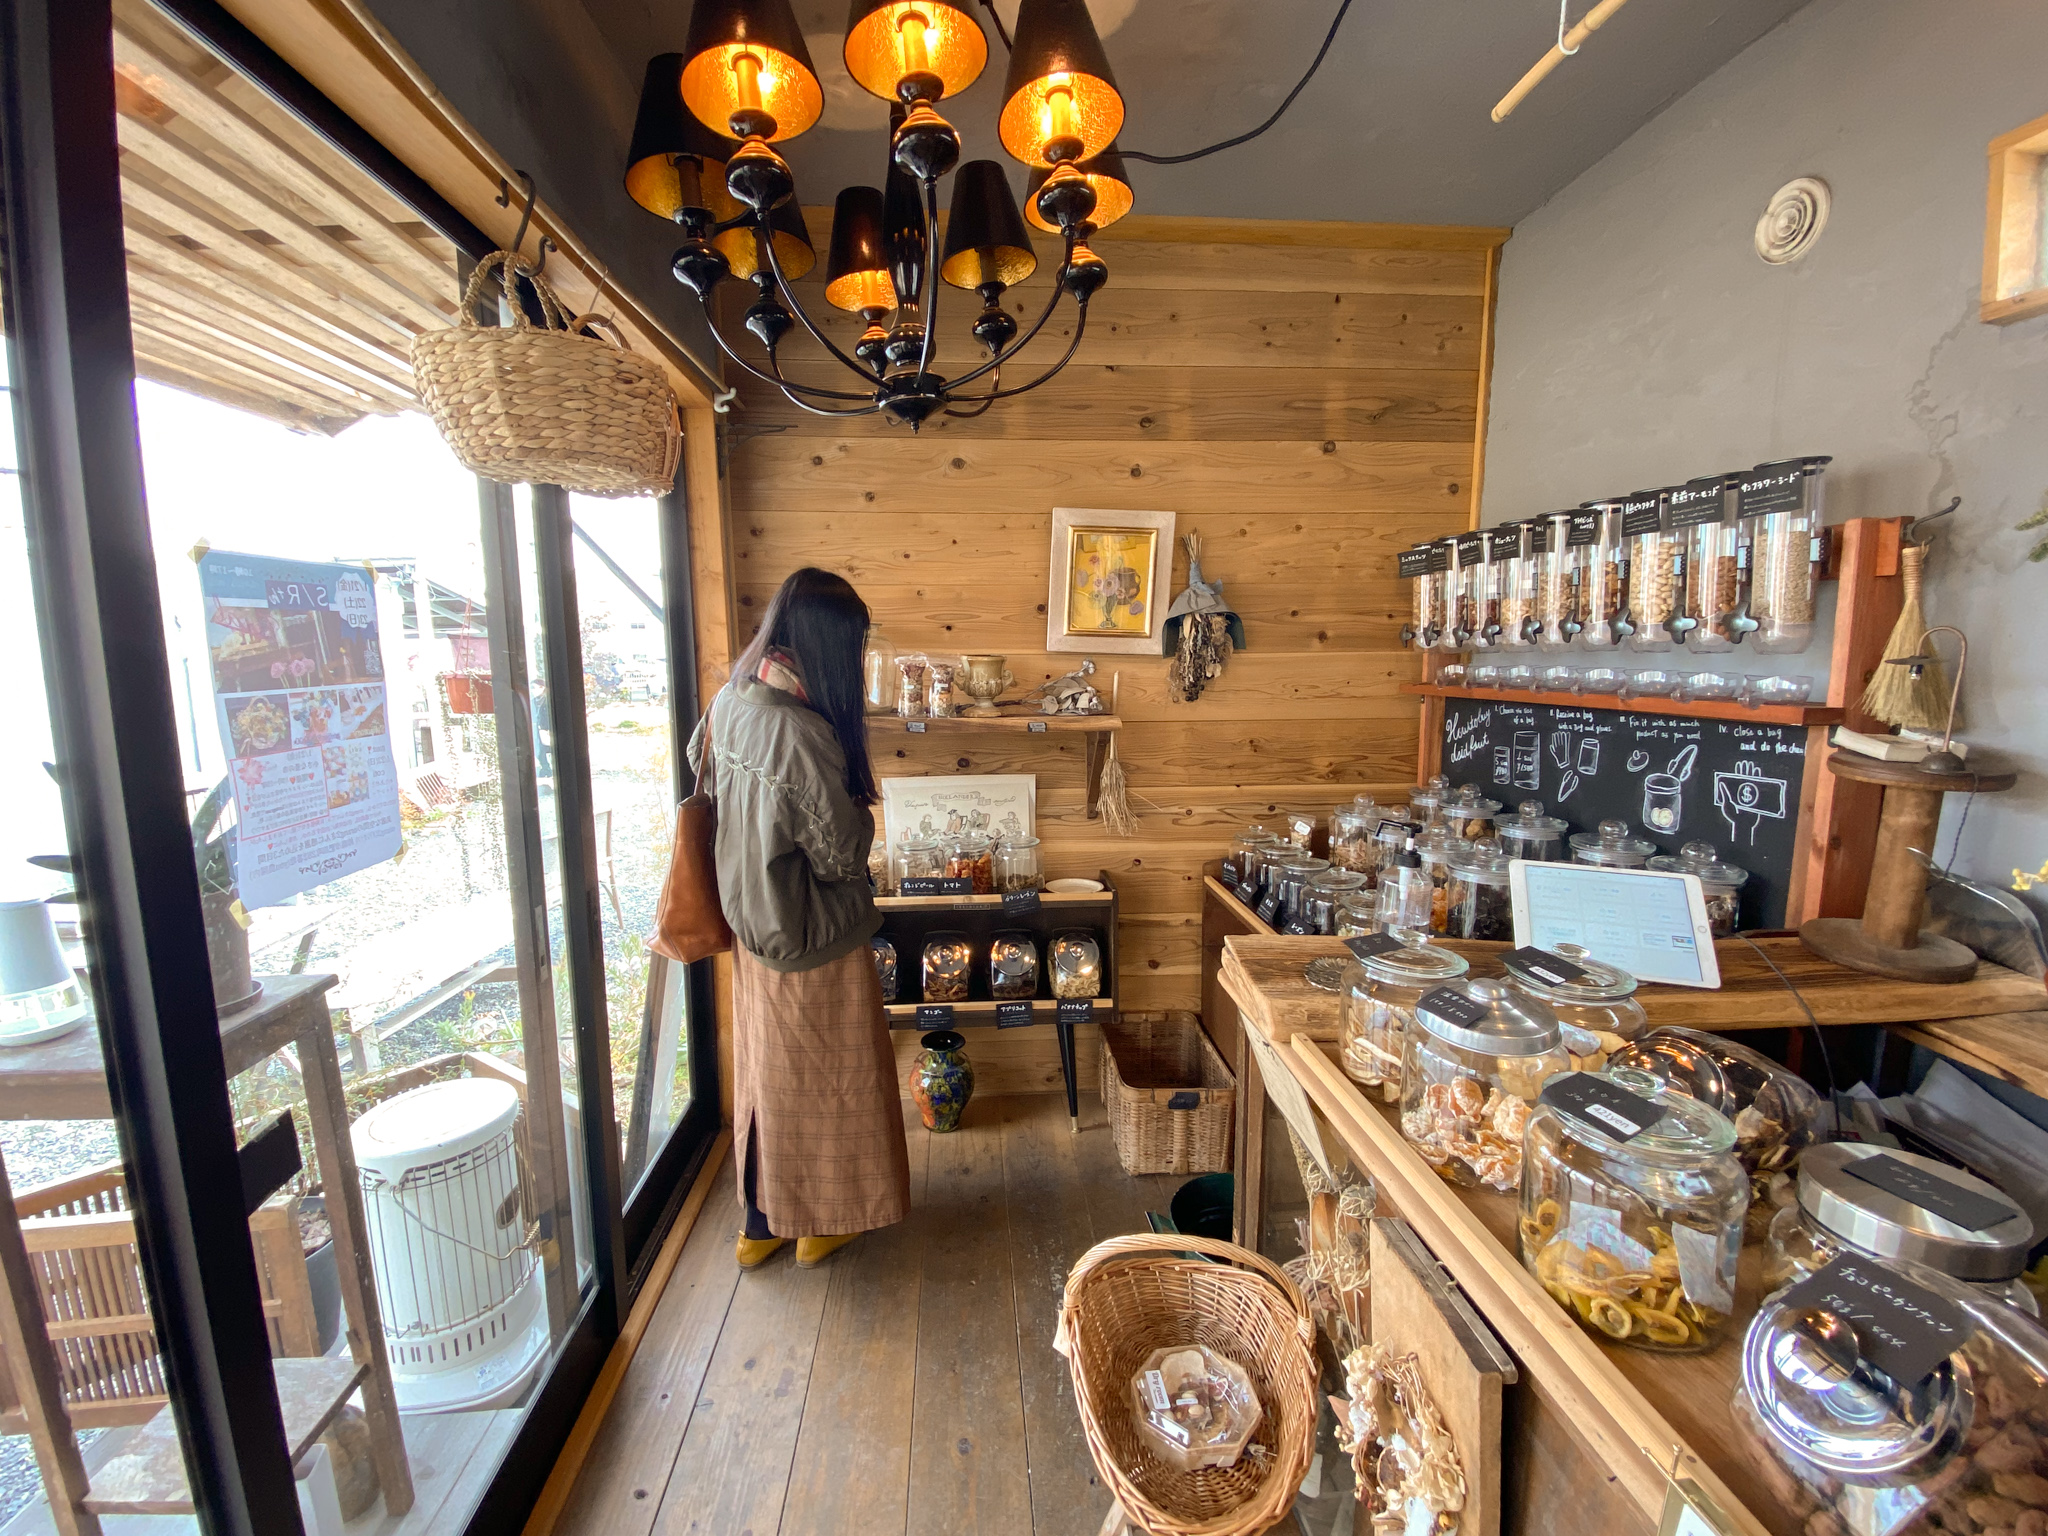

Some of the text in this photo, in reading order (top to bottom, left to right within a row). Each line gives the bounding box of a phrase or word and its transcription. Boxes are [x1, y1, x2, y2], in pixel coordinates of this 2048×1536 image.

[1756, 728, 1764, 736] a
[1766, 727, 1782, 740] bag
[1739, 740, 1757, 751] and
[943, 881, 962, 889] トマト
[1591, 1105, 1631, 1129] 421yen
